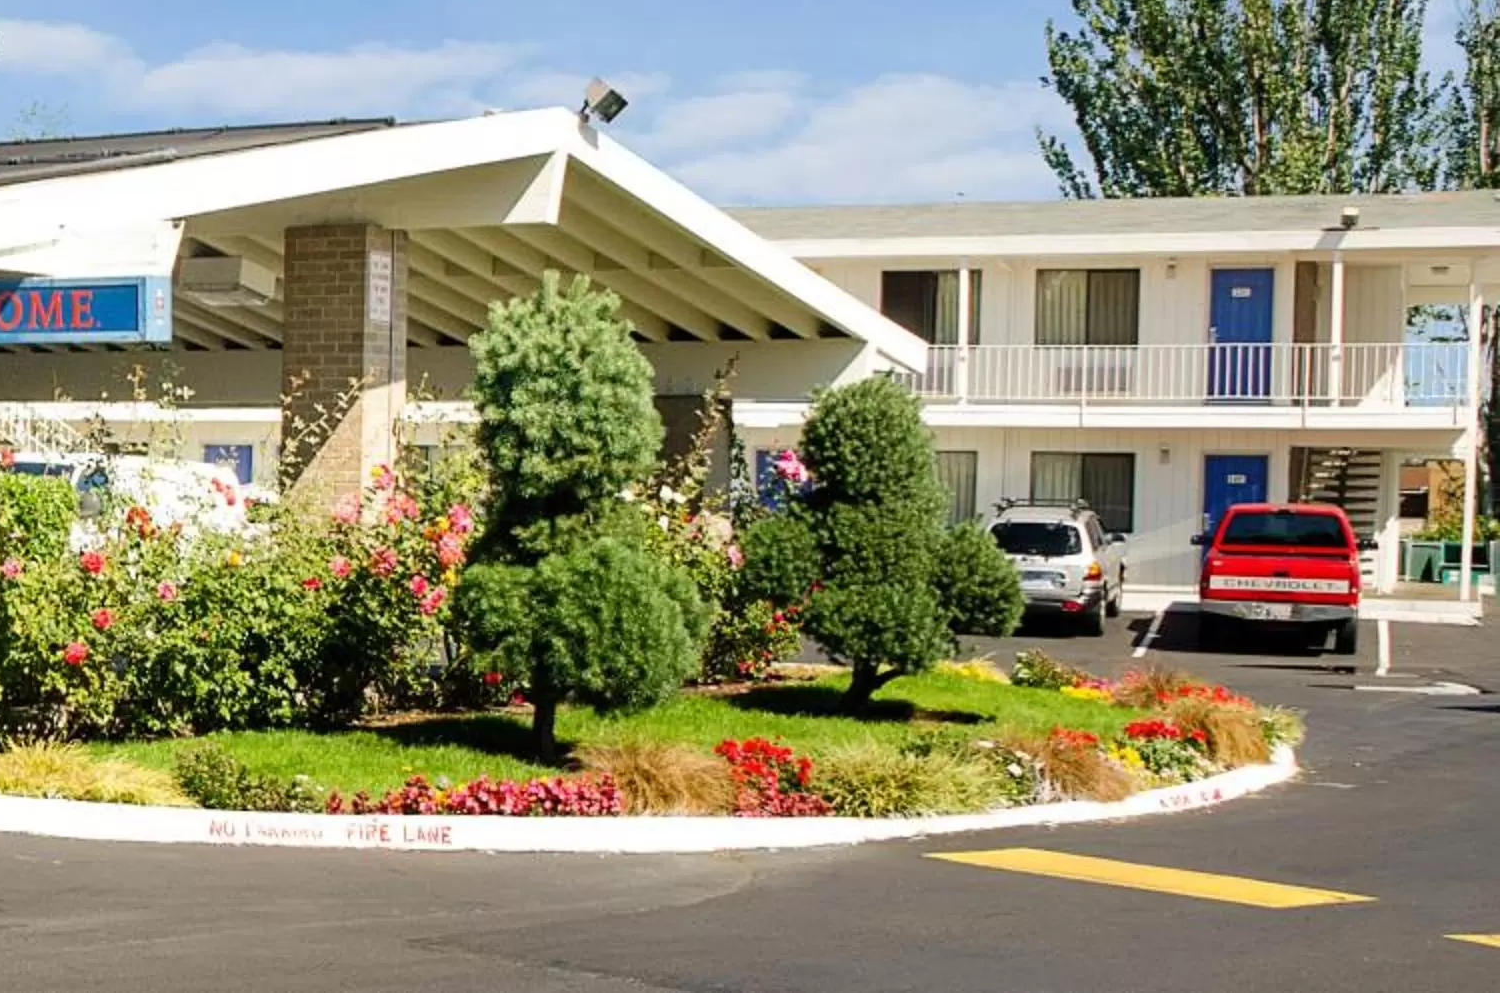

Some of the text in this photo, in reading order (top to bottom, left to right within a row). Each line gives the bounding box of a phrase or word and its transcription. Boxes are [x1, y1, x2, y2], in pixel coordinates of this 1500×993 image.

[1222, 578, 1334, 590] CHEVROLET
[347, 822, 392, 843] FIRE
[403, 824, 453, 845] LANE
